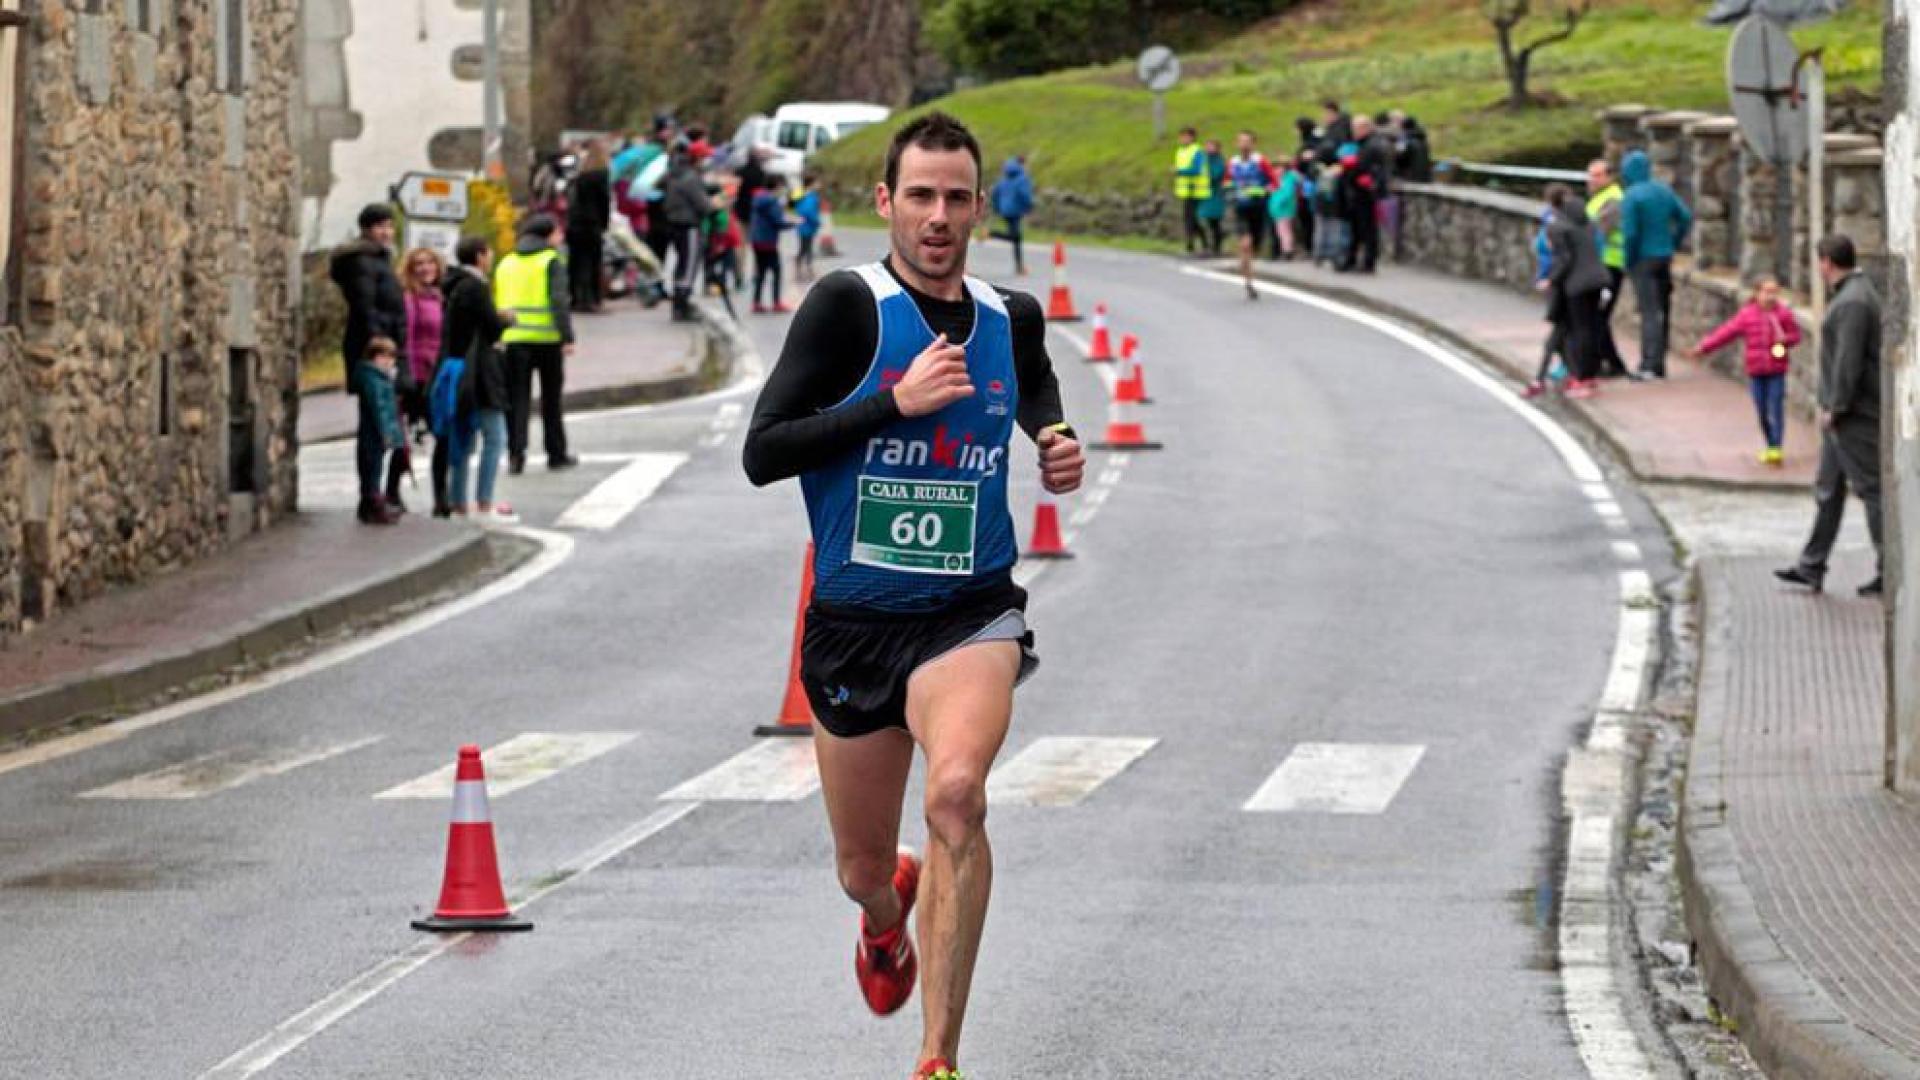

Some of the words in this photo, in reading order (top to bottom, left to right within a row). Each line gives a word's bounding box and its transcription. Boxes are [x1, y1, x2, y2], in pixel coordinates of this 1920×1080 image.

[865, 425, 1003, 476] ranking
[914, 484, 968, 501] RURAL
[891, 511, 943, 547] 60
